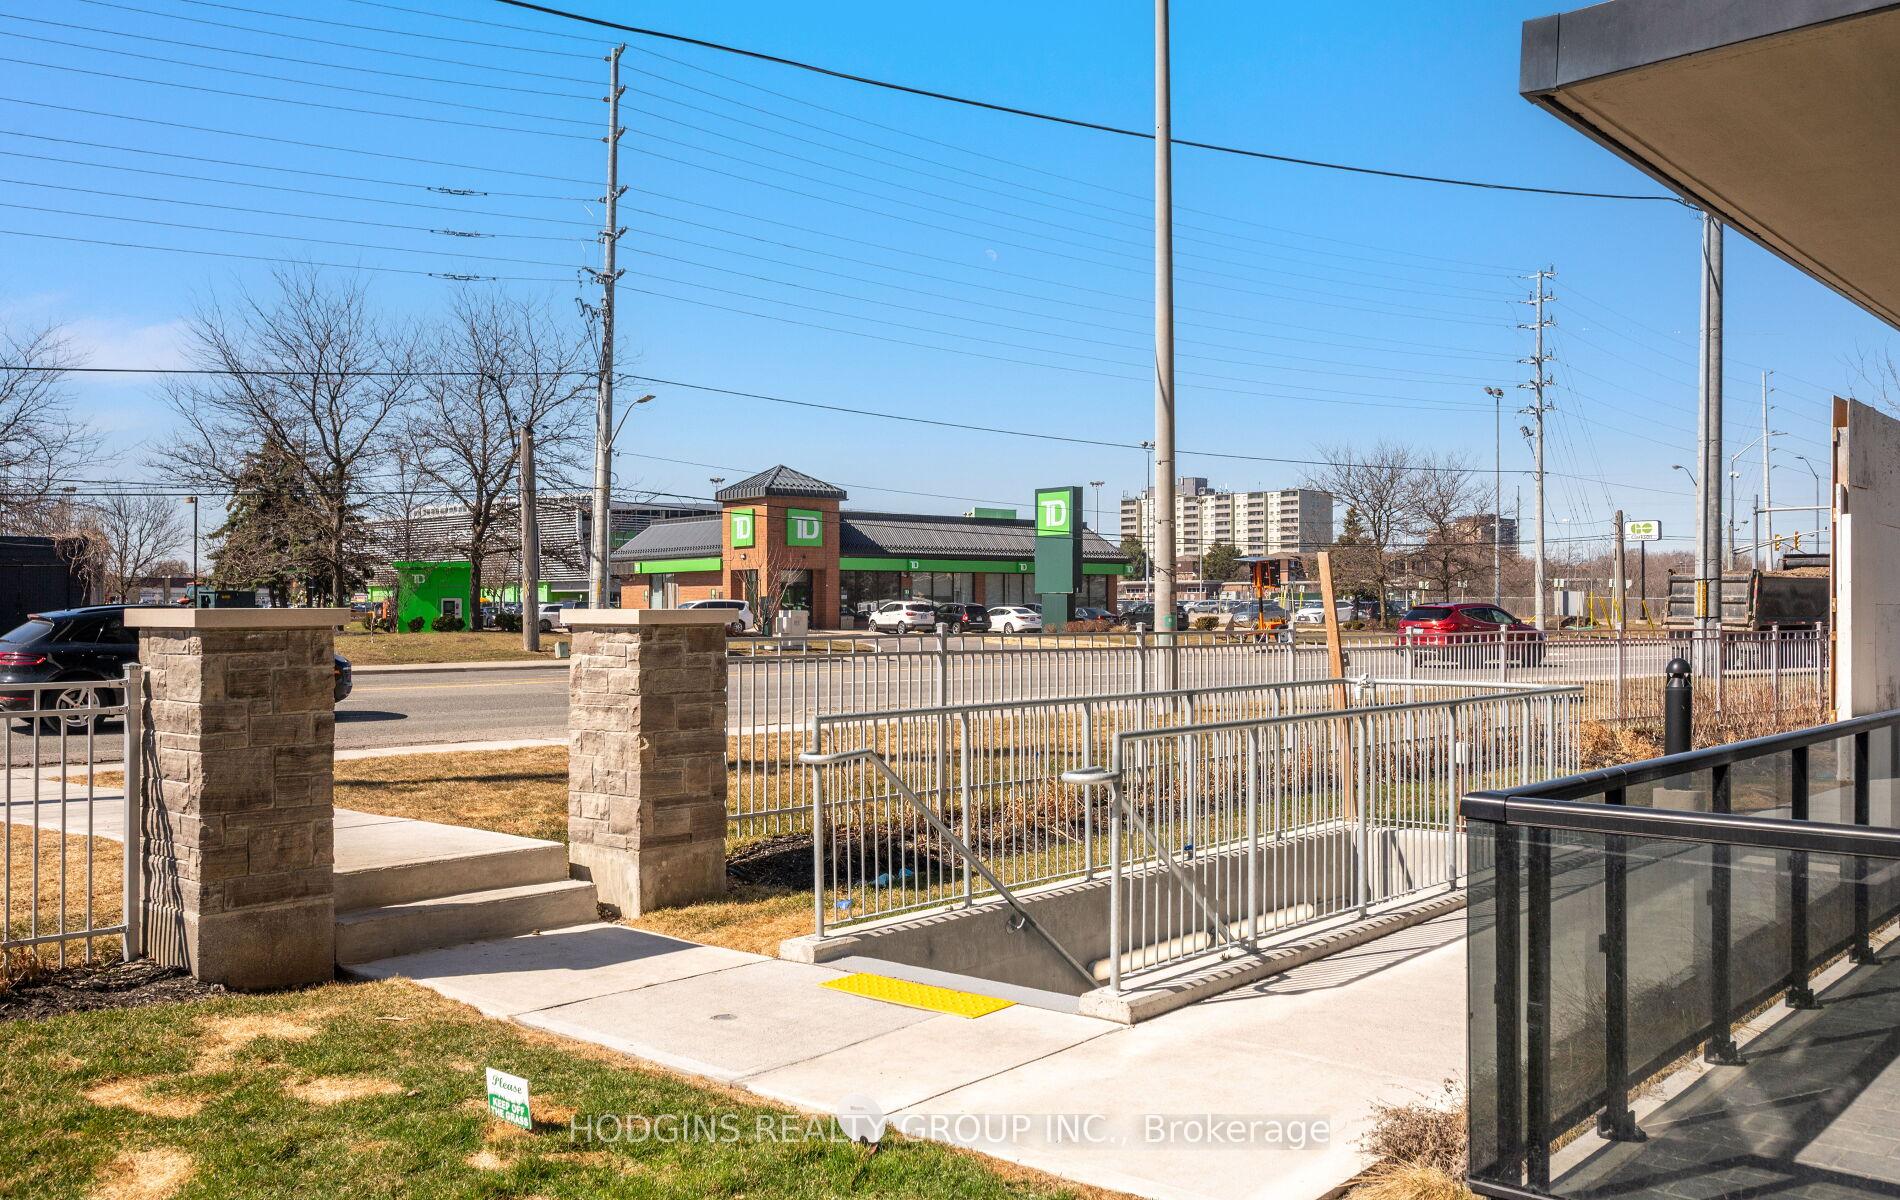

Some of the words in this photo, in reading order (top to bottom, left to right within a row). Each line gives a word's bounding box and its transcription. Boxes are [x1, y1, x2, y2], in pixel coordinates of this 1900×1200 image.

[1041, 500, 1066, 527] TD
[734, 517, 750, 539] TD
[792, 516, 819, 539] TD
[492, 1075, 522, 1094] Please
[490, 1106, 505, 1119] THE
[505, 1111, 528, 1127] GRASS
[492, 1097, 510, 1111] KEEP
[511, 1104, 525, 1116] OFF
